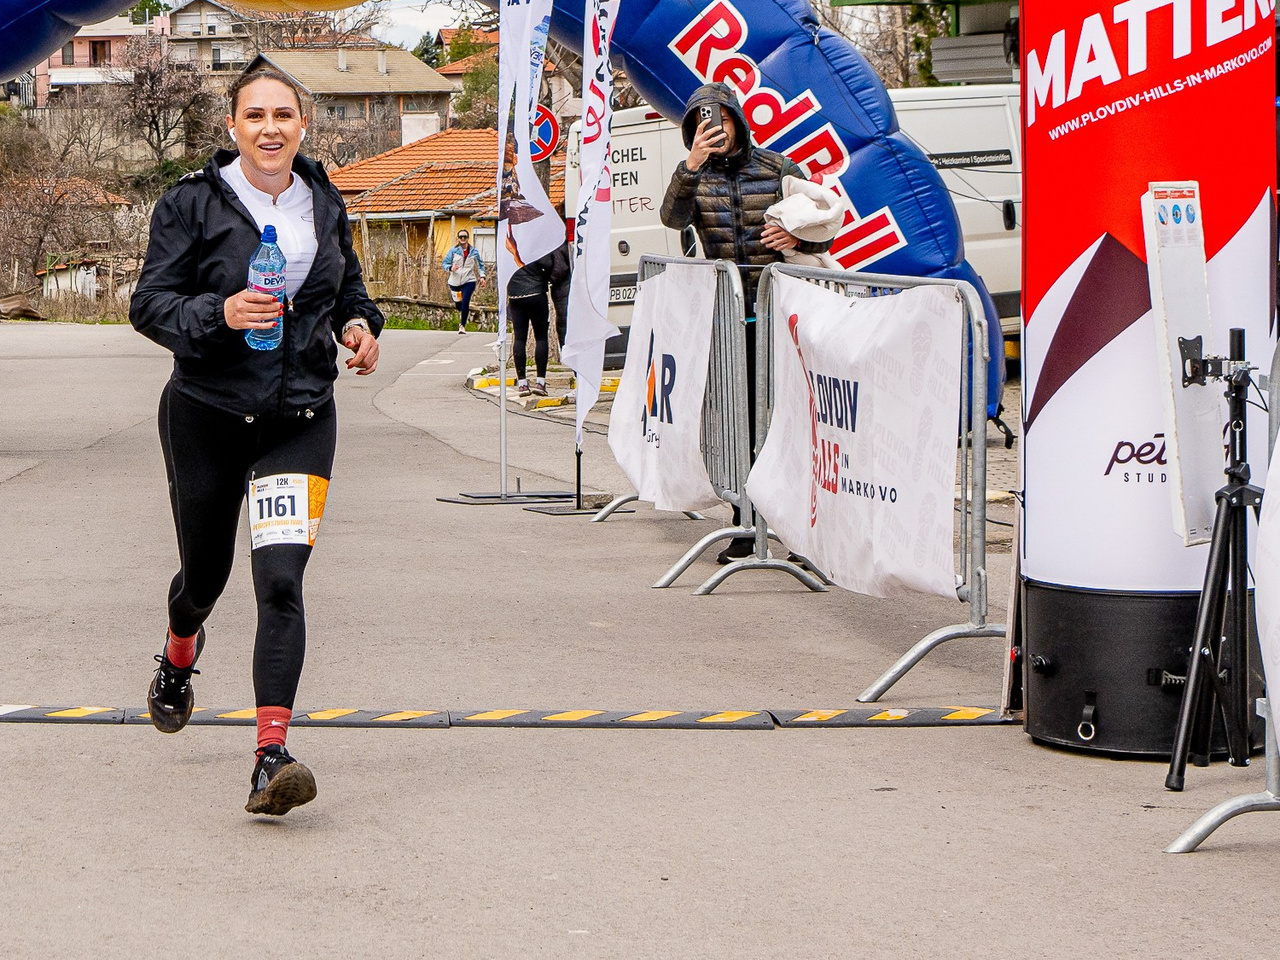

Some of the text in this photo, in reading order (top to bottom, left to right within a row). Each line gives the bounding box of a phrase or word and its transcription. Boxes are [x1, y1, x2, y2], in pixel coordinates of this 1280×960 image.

[1049, 36, 1272, 141] WWW.PLOVDIV-HILLS-IN-MARKOVO.COM
[675, 2, 900, 269] Red Bll
[611, 147, 646, 164] CHEL
[612, 171, 638, 187] FEN
[612, 197, 655, 214] ITER
[622, 288, 637, 299] 027
[276, 478, 289, 486] 12K
[1124, 472, 1167, 483] STUD
[257, 495, 296, 520] 1161
